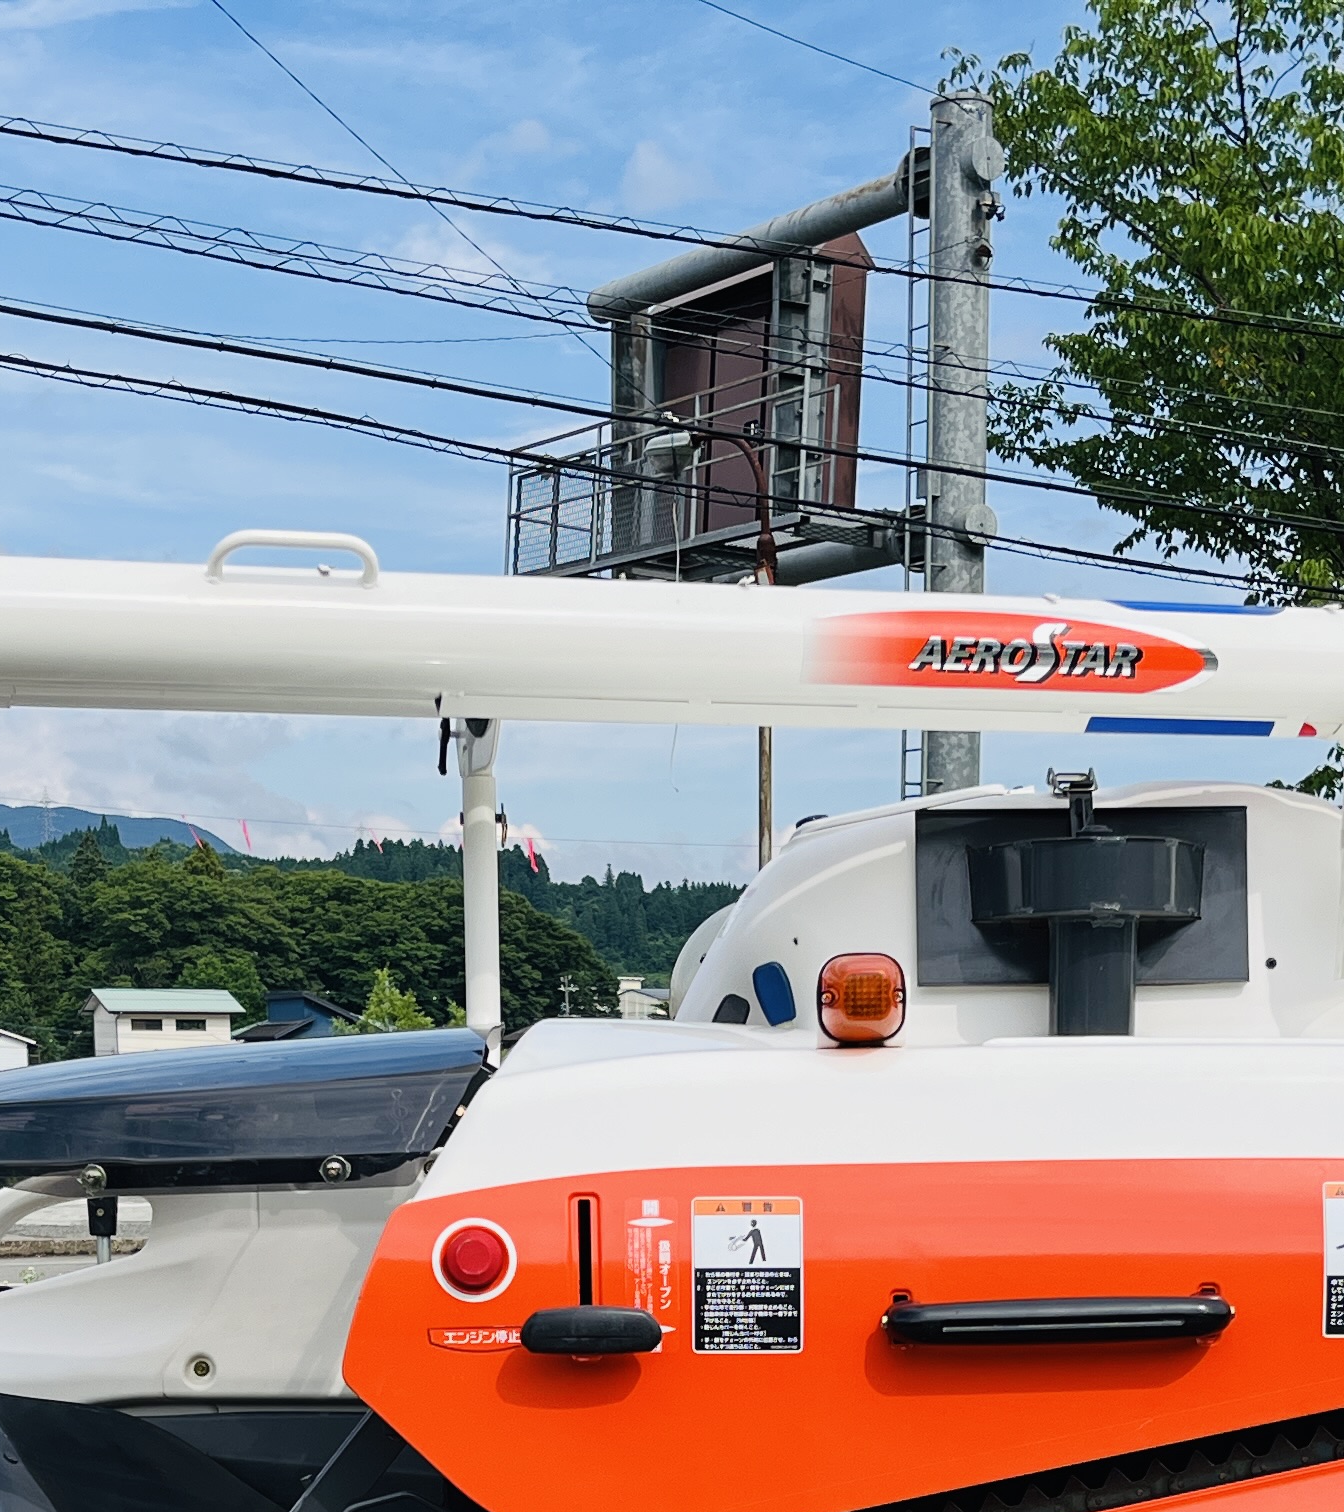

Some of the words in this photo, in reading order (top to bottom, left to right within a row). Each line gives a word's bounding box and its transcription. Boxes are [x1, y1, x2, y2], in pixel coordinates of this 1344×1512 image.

[907, 623, 1144, 683] AEROSTAR
[444, 1330, 521, 1344] エンジン停止
